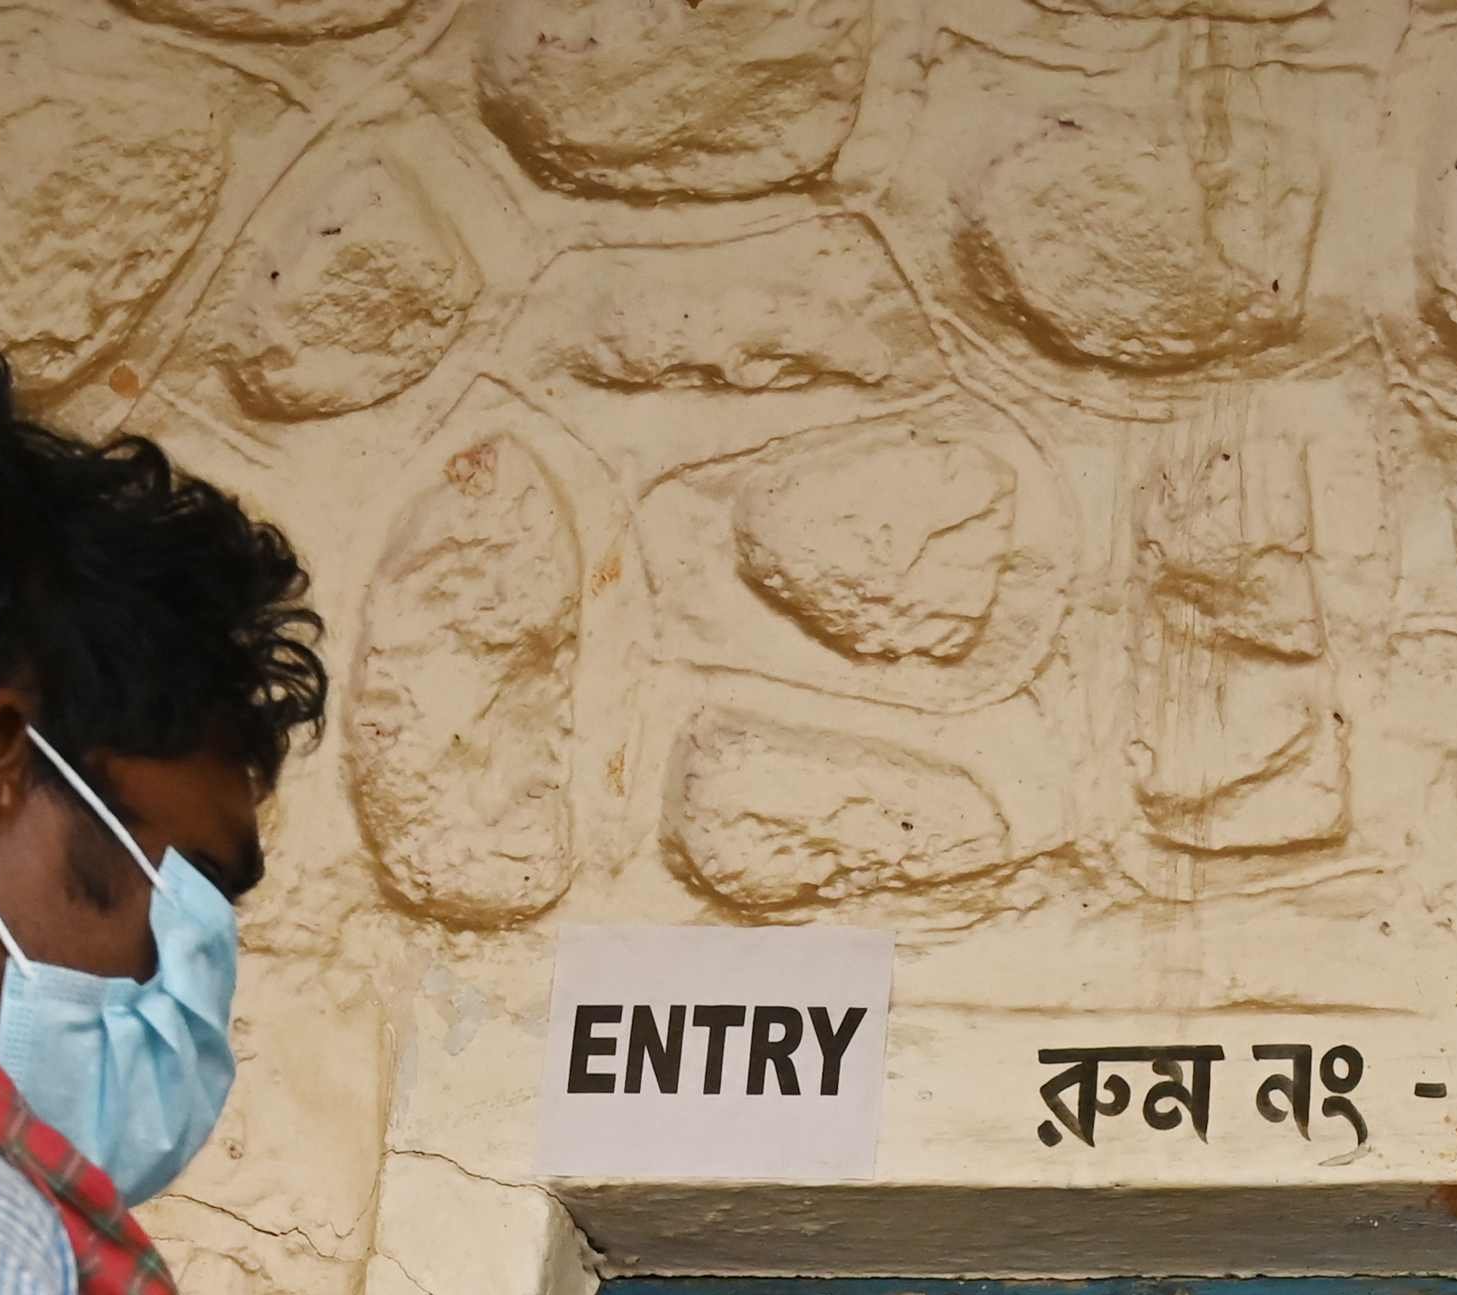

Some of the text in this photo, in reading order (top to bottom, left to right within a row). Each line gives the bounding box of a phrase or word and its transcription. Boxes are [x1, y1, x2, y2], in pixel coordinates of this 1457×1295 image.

[567, 1004, 868, 1096] ENTRY
[1036, 1045, 1224, 1148] রুম
[1251, 1044, 1368, 1150] নং
